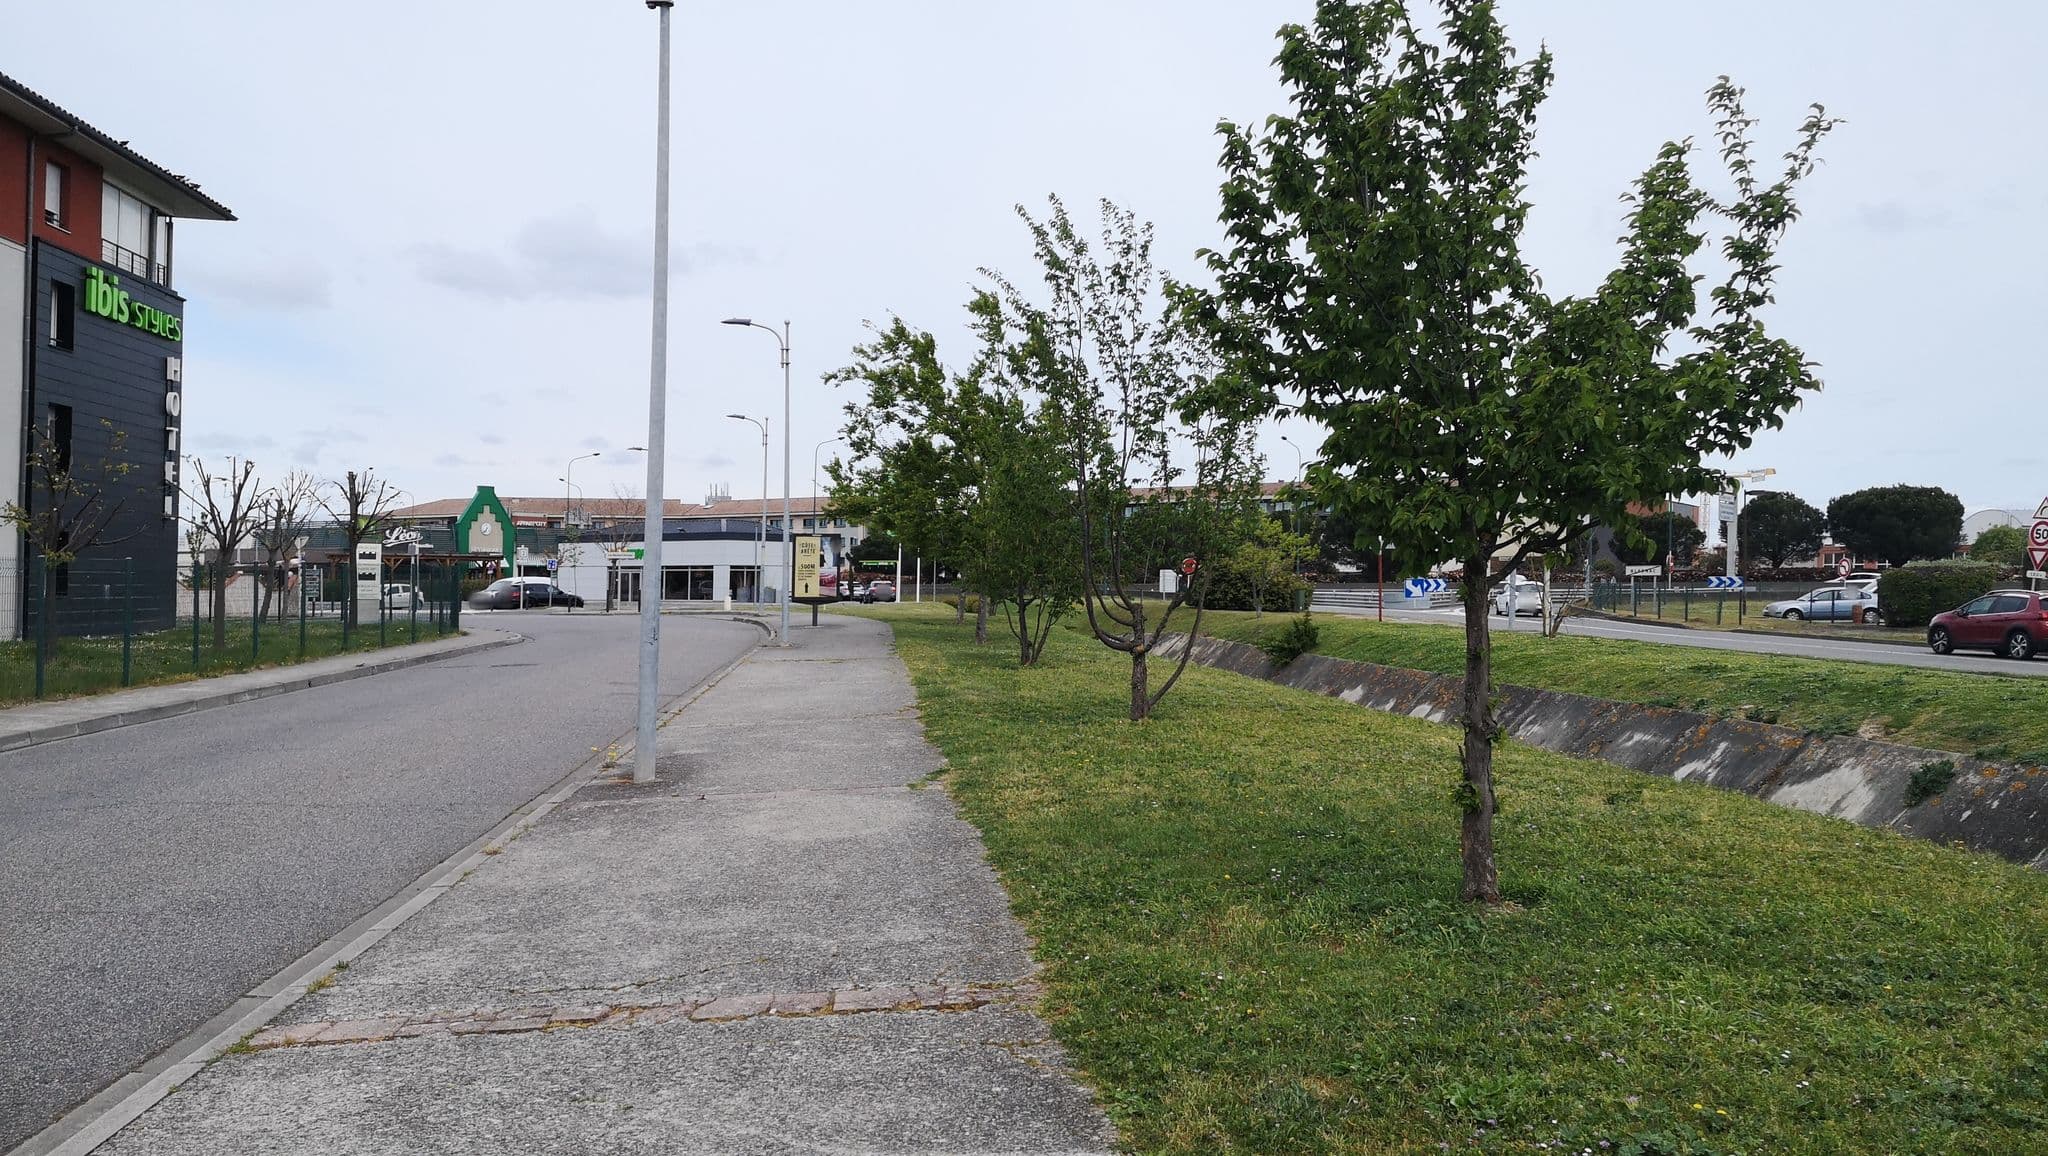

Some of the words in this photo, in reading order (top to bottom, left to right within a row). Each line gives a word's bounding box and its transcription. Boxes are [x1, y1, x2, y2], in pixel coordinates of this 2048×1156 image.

[87, 267, 130, 323] ibis
[165, 357, 180, 521] HOTEL
[2035, 528, 2048, 540] 50
